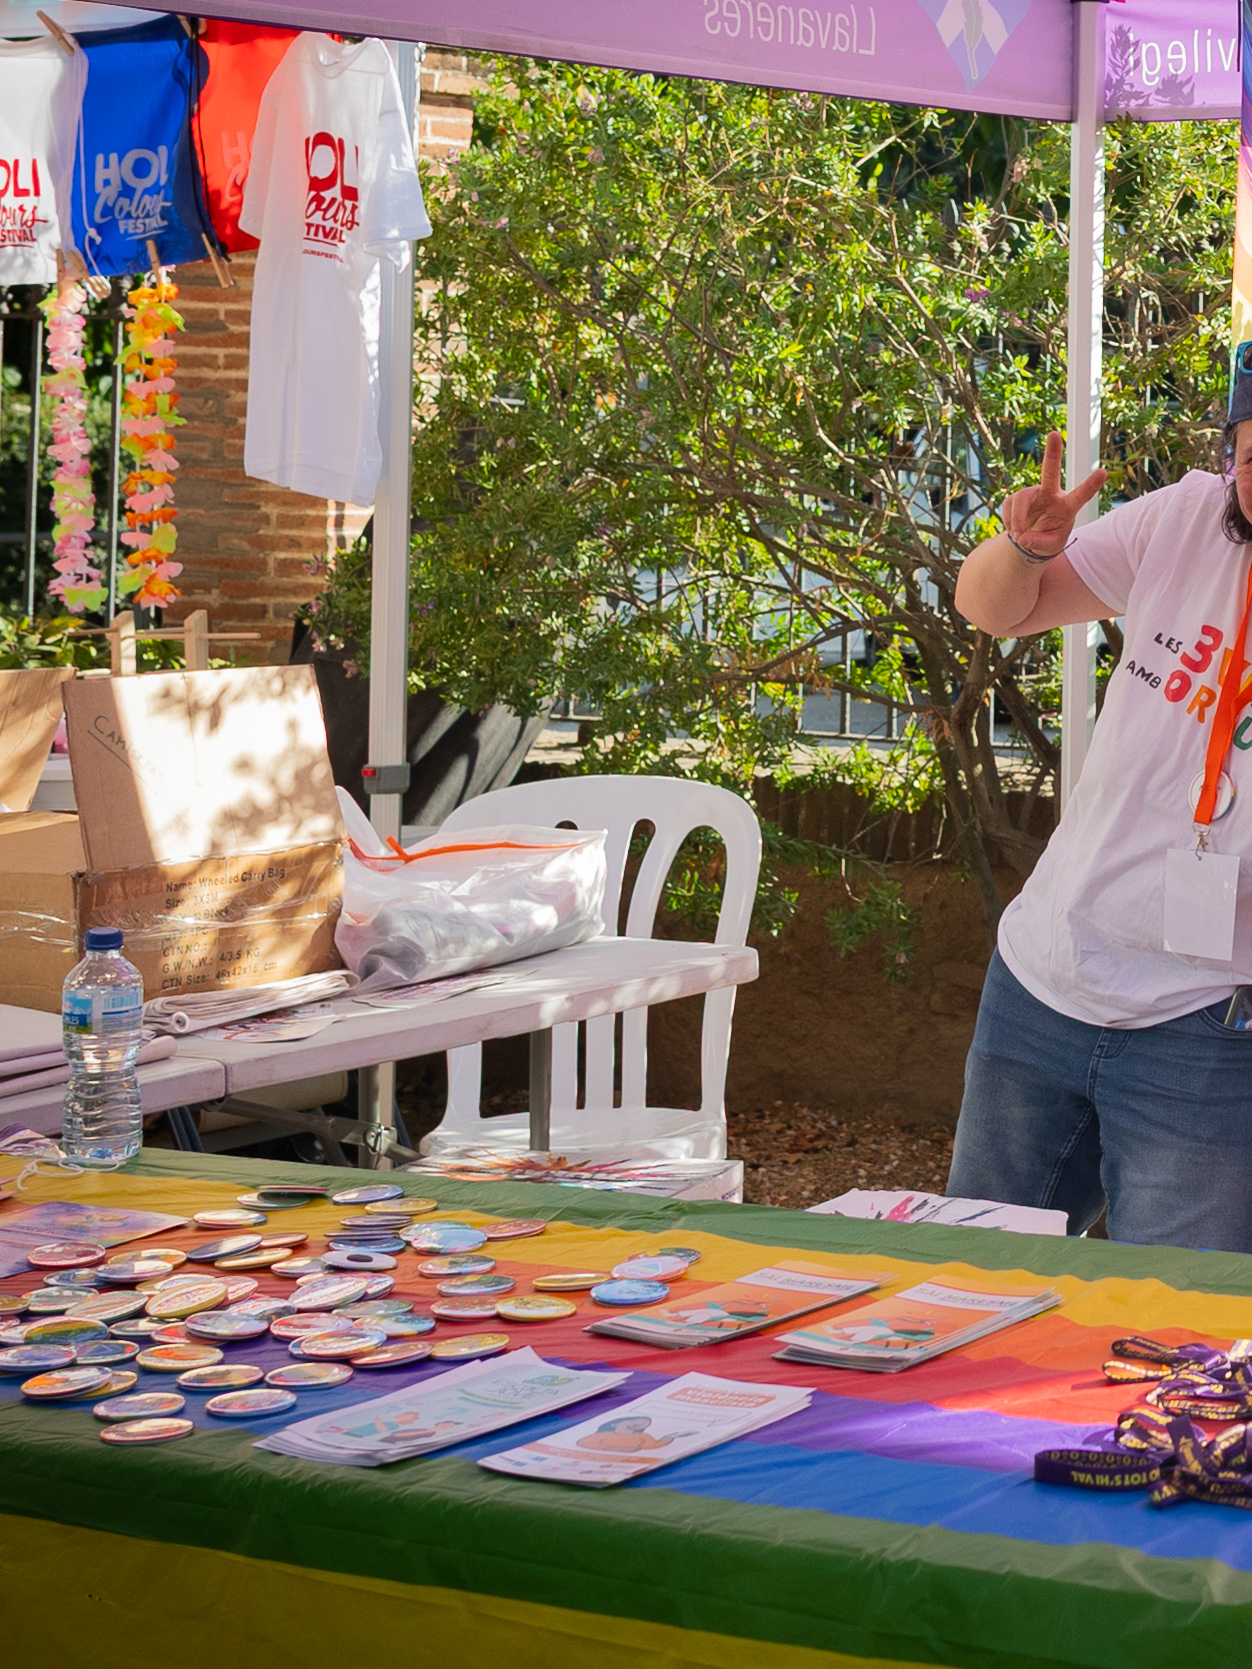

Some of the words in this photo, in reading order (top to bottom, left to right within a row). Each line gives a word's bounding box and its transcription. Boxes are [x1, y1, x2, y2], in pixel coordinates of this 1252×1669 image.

[1153, 631, 1184, 655] LES
[1179, 624, 1224, 674] 3
[1125, 659, 1162, 689] AMB
[165, 880, 197, 893] Name:
[198, 873, 240, 888] Wheeled
[240, 871, 266, 883] Carry
[267, 867, 286, 880] Bag
[165, 896, 190, 909] Size:
[162, 957, 214, 974] G.W./N.W.:
[218, 949, 242, 962] 4/3.5
[246, 947, 261, 960] KG
[161, 977, 184, 990] CTN
[185, 973, 210, 986] Size:
[263, 961, 278, 971] cm
[1069, 1470, 1095, 1485] VAL
[1095, 1473, 1122, 1487] S'HI
[1123, 1472, 1148, 1487] TOT
